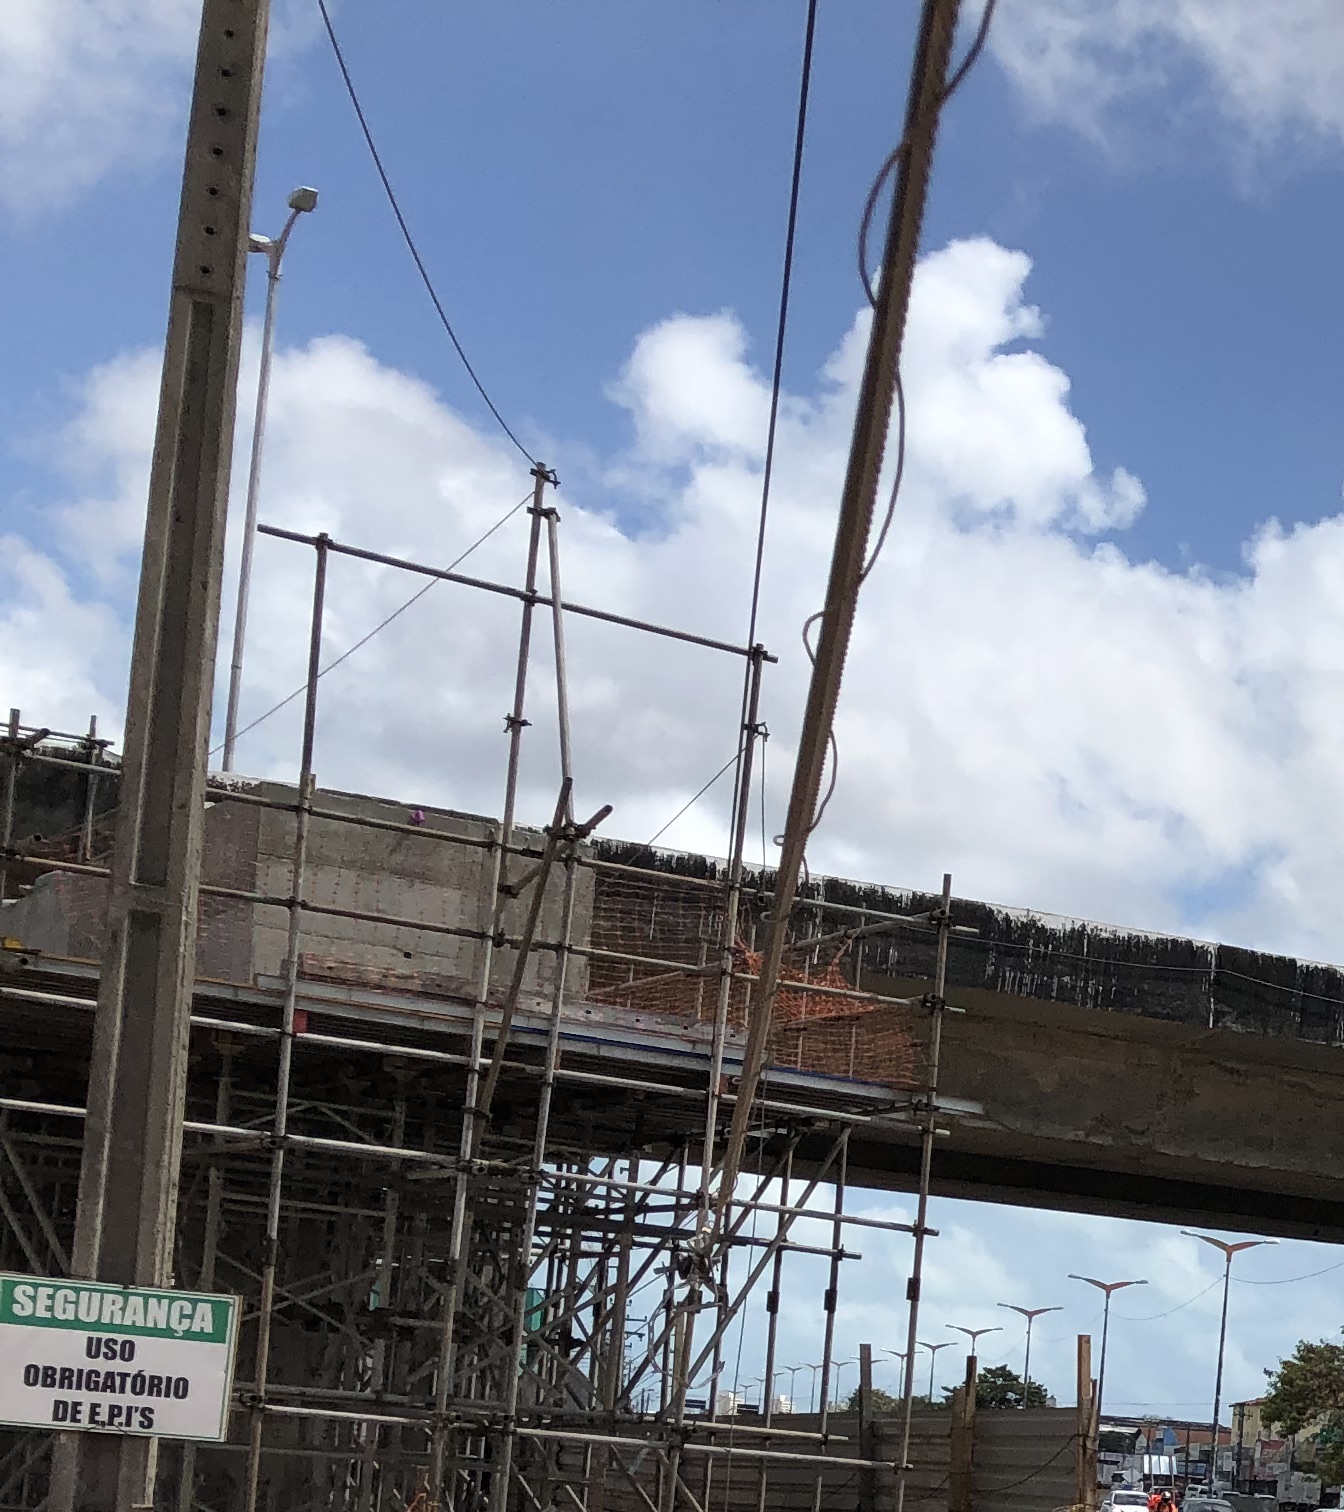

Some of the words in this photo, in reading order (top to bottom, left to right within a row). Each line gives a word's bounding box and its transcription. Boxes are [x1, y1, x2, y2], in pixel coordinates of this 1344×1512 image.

[11, 1284, 214, 1337] SEGURANÇA
[85, 1335, 136, 1362] USO
[23, 1363, 189, 1400] OBRIGATÓRIO
[52, 1399, 83, 1424] DE
